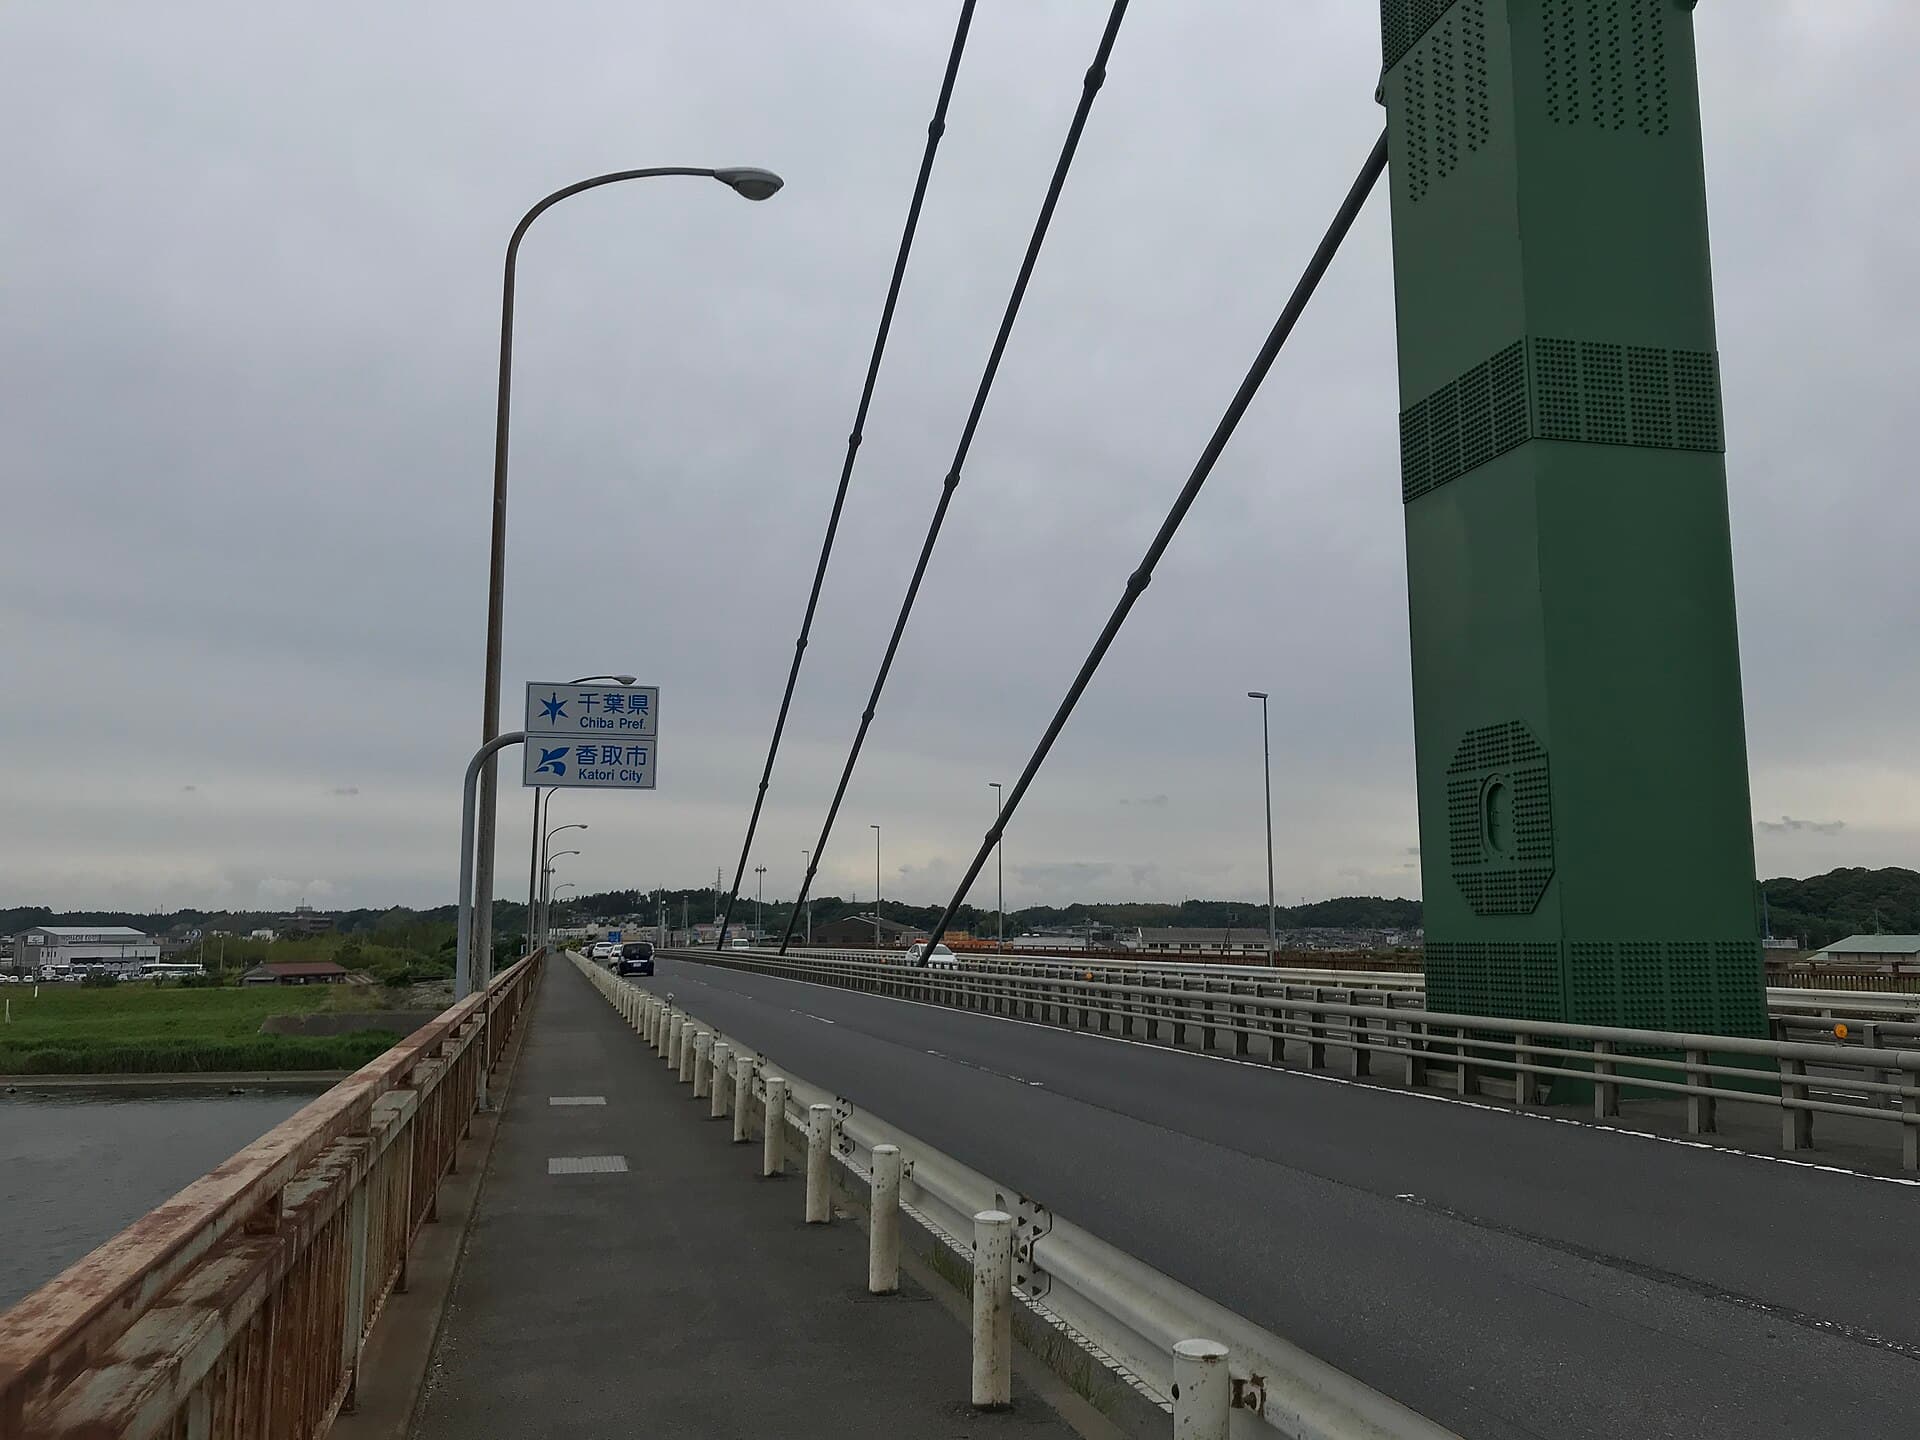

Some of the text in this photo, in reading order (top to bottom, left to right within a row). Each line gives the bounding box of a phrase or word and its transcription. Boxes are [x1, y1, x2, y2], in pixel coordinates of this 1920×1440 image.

[578, 693, 649, 715] 千葉県
[580, 716, 646, 730] Chiba Pref.
[576, 745, 648, 767] 香取市
[578, 769, 642, 783] Katori City
